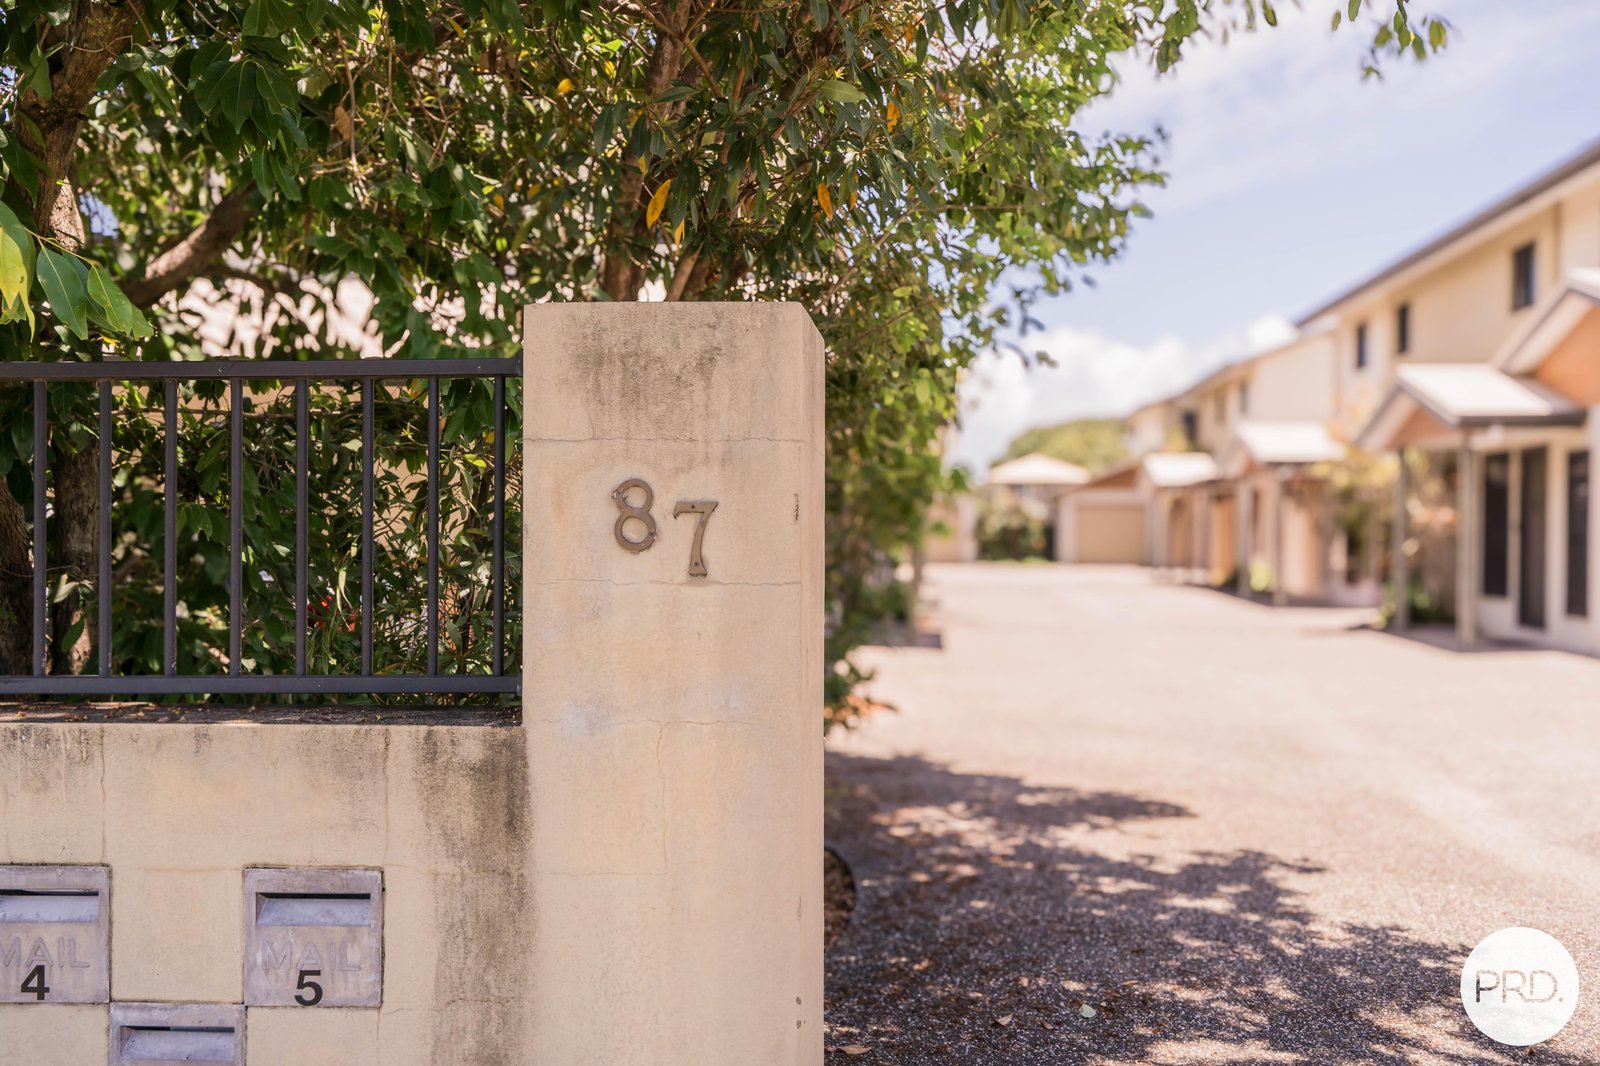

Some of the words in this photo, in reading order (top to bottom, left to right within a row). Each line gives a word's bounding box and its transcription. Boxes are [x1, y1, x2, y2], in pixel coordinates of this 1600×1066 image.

[612, 478, 719, 577] 87
[263, 939, 363, 971] MAIL
[21, 965, 50, 1000] 4
[294, 970, 323, 1006] 5
